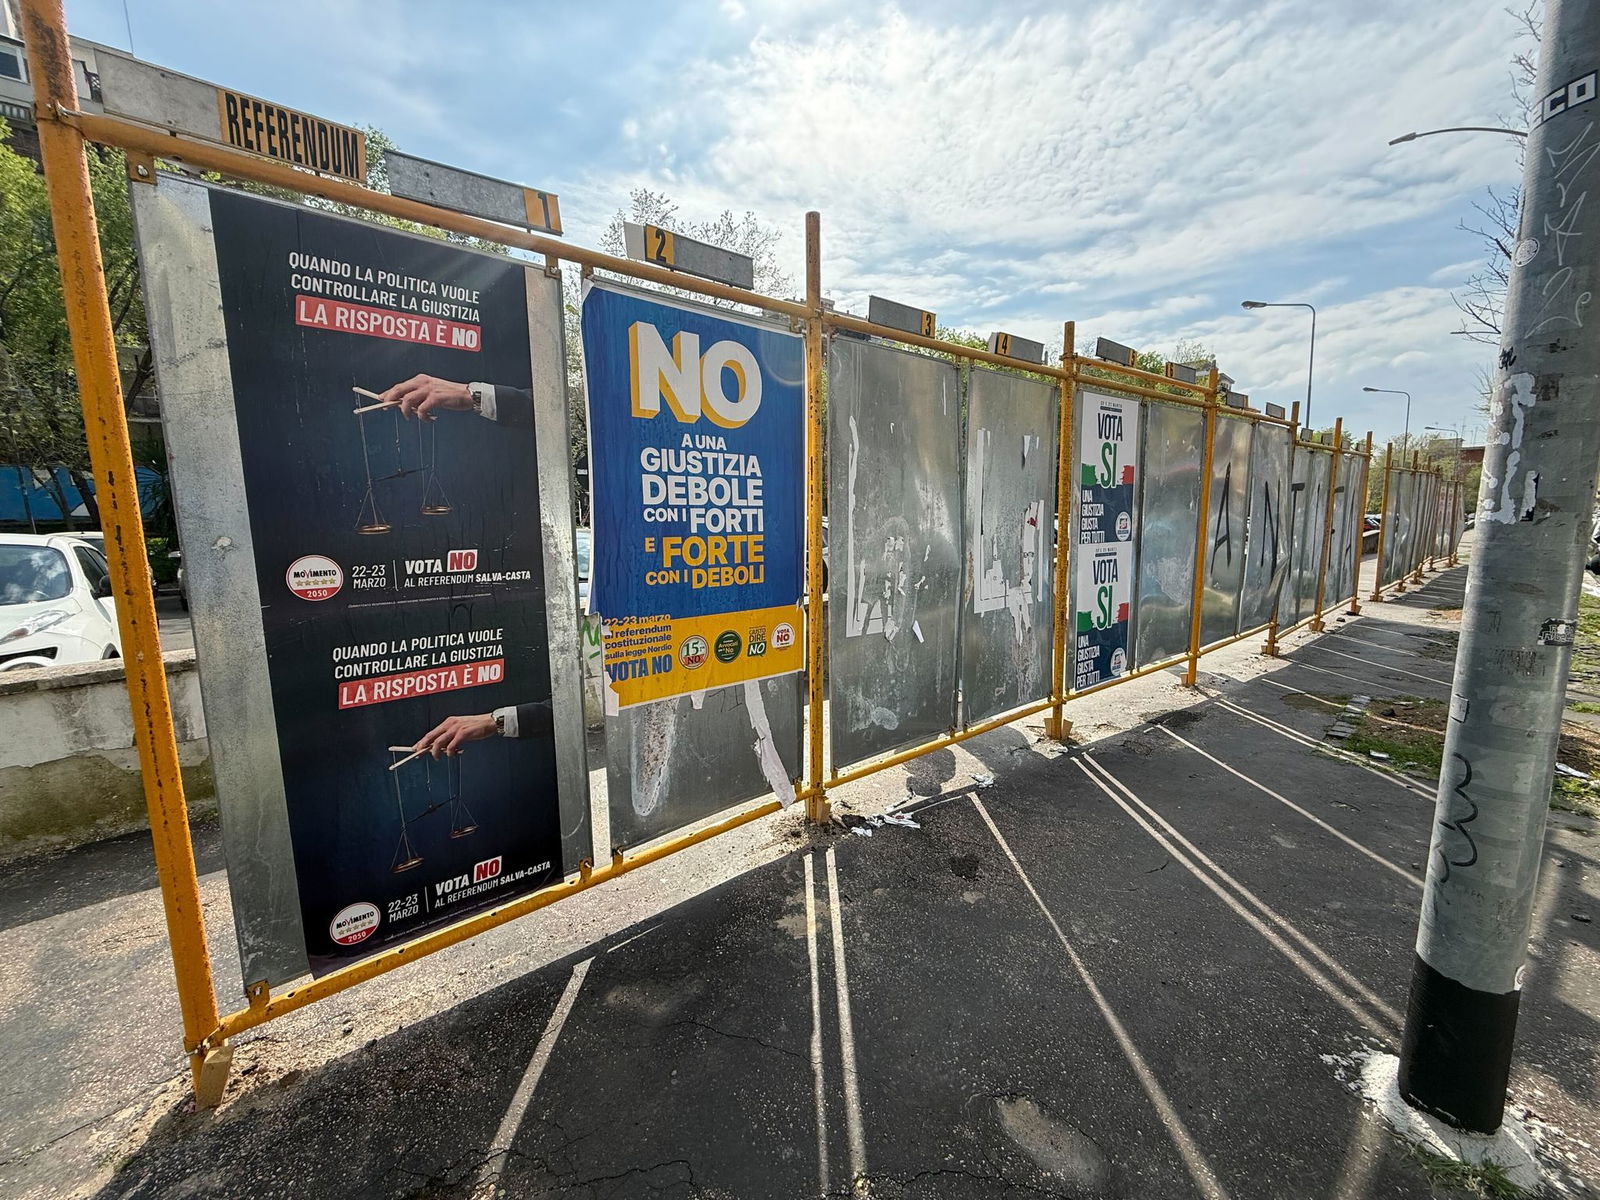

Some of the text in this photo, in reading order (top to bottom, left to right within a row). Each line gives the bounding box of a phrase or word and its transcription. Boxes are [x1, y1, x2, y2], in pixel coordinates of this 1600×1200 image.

[225, 92, 359, 179] REFERENDUM
[538, 192, 551, 229] 1
[655, 229, 666, 262] 2
[289, 251, 480, 304] QUANDO LA POLITICA VUOLE
[291, 273, 480, 322] CONTROLLARE LA GIUSTIZIA
[300, 300, 478, 349] LA RISPOSTA È NO
[925, 313, 931, 336] 3
[1002, 334, 1007, 354] 4
[628, 320, 762, 428] NO
[1098, 412, 1122, 442] VOTA
[681, 433, 727, 450] A UNA
[640, 447, 762, 477] GIUSTIZIA
[641, 474, 764, 507] DEBOLE
[643, 508, 764, 533] CON I FORTI
[1082, 518, 1098, 530] GIUSTA
[1081, 532, 1091, 544] PER
[644, 534, 764, 568] E FORTE
[352, 565, 386, 577] 22-23
[405, 552, 476, 575] VOTA NO
[1093, 558, 1118, 585] VOTA
[353, 577, 386, 589] MARZO
[404, 571, 531, 588] AL REFERENDUM SALVA-CASTA
[645, 565, 764, 589] CON I DEBOLI
[307, 590, 328, 598] 2050
[639, 614, 671, 624] marzo
[605, 633, 672, 649] costituzionale
[616, 625, 672, 638] referendum
[749, 634, 766, 642] DIRE
[777, 634, 790, 642] NO
[332, 628, 503, 663] QUANDO LA POLITICA VUOLE
[605, 643, 672, 660] sulla legge Nordio
[685, 640, 700, 657] 15
[749, 643, 766, 655] NO
[335, 645, 503, 679] CONTROLLARE LA GIUSTIZIA
[605, 654, 672, 683] VOTA NO
[688, 655, 700, 664] NO
[1077, 660, 1094, 675] GIUSTA
[342, 664, 500, 706] LA RISPOSTA È NO
[1077, 674, 1086, 688] PER
[434, 861, 550, 909] AL REFERENDUM SALVA-CASTA
[436, 859, 500, 896] VOTA NO
[388, 894, 418, 913] 22-23
[389, 904, 418, 924] MARZO
[348, 932, 367, 943] 2050
